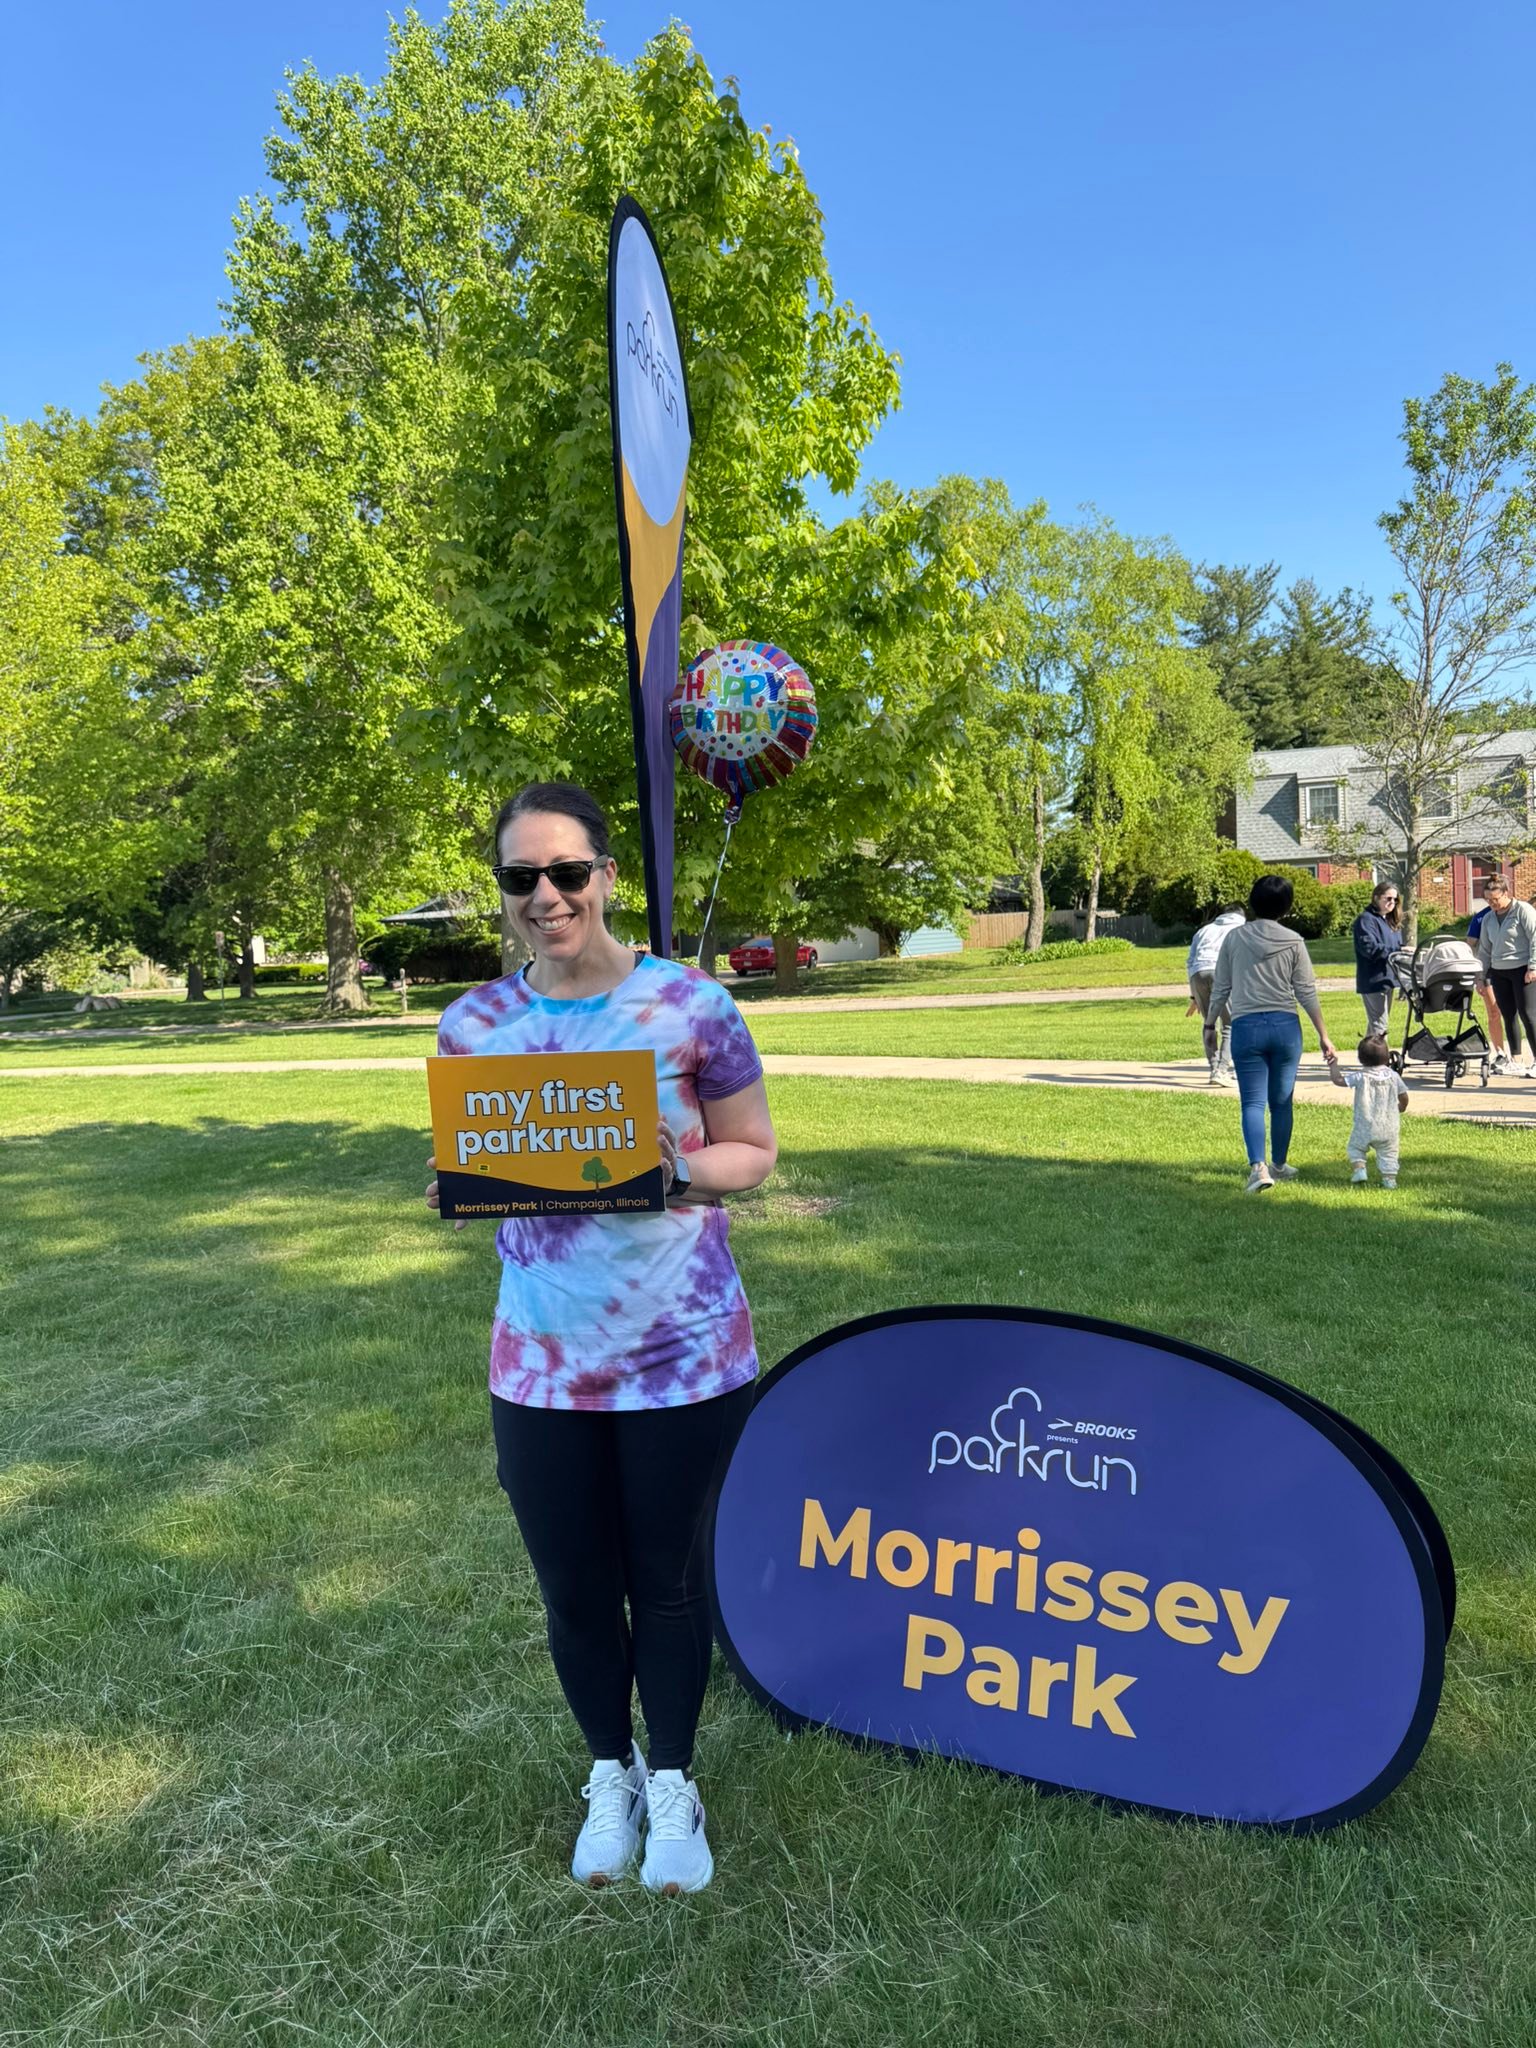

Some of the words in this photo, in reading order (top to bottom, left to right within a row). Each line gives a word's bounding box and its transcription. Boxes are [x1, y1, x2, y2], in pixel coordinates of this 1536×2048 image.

[626, 310, 680, 429] parkrun
[686, 669, 788, 706] HAPPY
[682, 703, 785, 735] BIRTHDAY
[465, 1089, 534, 1125] my
[540, 1079, 624, 1114] first
[456, 1118, 637, 1166] parkrun!
[454, 1202, 510, 1214] Morrissey
[512, 1201, 538, 1211] Park
[546, 1199, 615, 1211] Champaign,
[616, 1197, 650, 1208] Illinois
[928, 1387, 1137, 1495] parkrun
[1046, 1434, 1079, 1445] presents
[1074, 1421, 1138, 1441] BROOKS
[799, 1498, 1291, 1675] Morrissey
[903, 1614, 1139, 1739] Park
